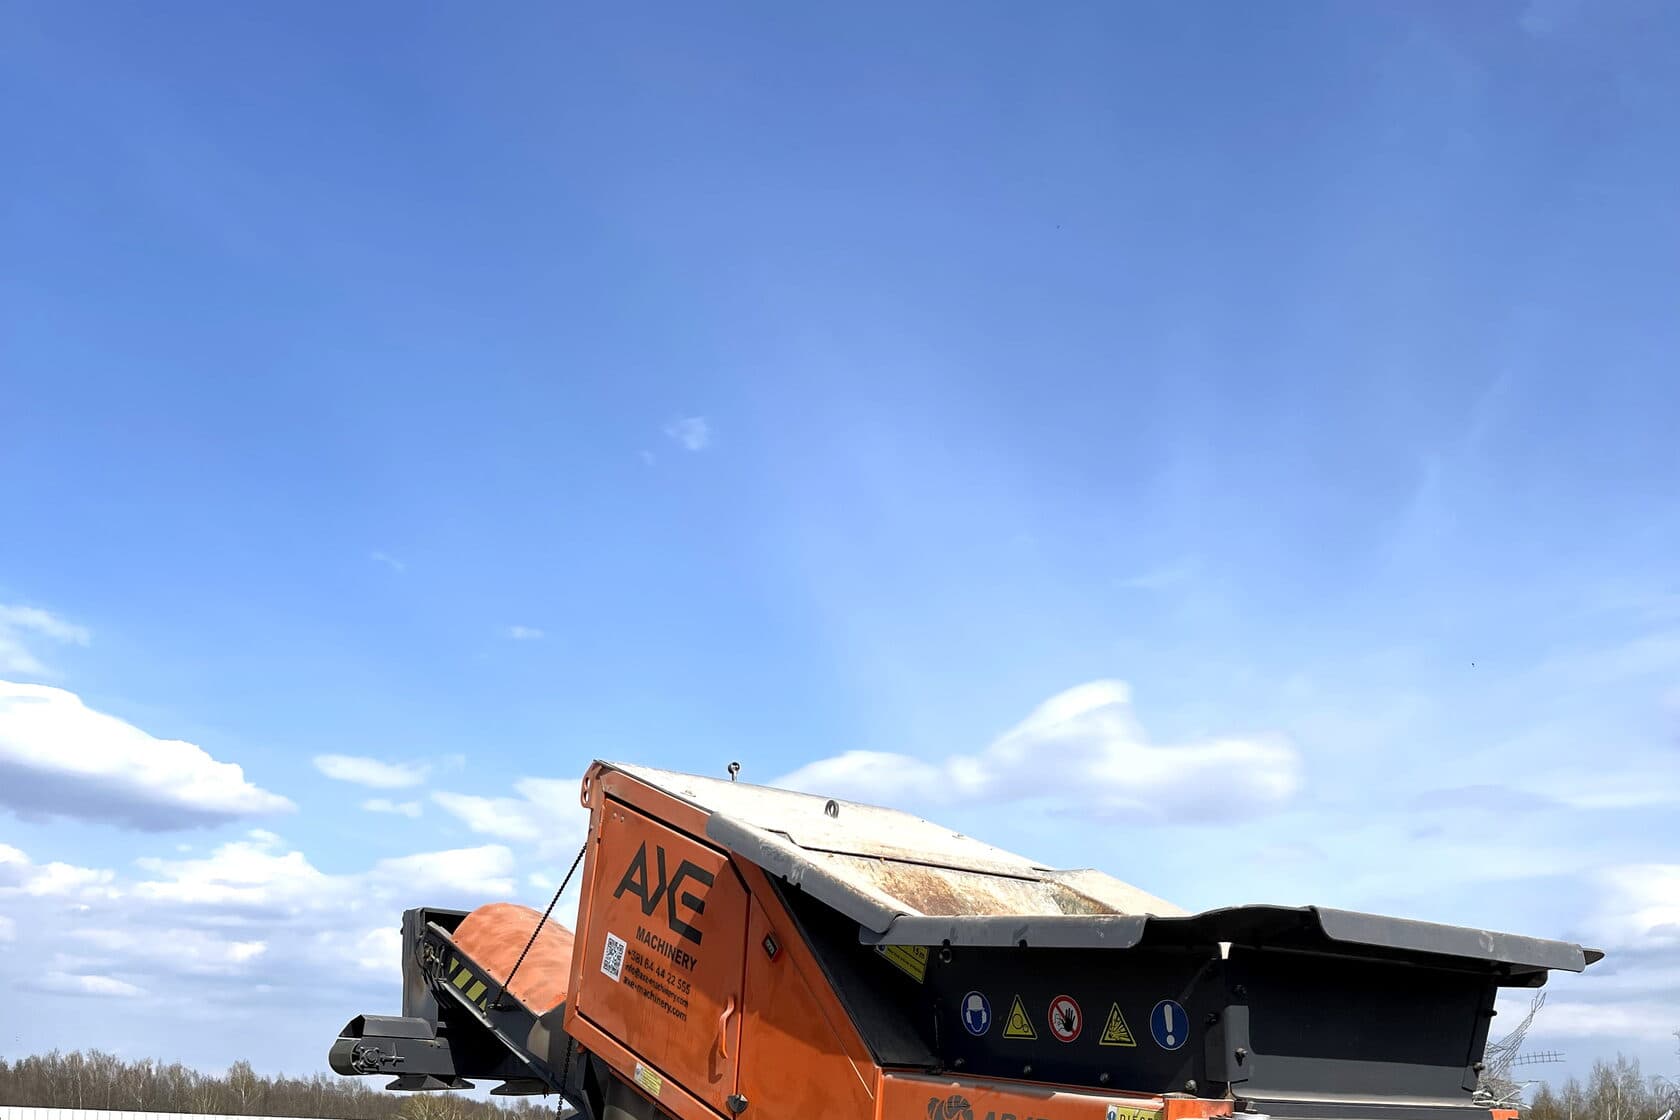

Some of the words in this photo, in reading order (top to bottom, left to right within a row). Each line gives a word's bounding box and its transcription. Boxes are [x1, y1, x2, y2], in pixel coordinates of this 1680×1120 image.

[613, 840, 715, 946] AXE
[636, 926, 698, 973] MACHINERY
[623, 976, 687, 1022] axe-machinery.com
[667, 972, 676, 986] 22
[677, 978, 691, 995] 555
